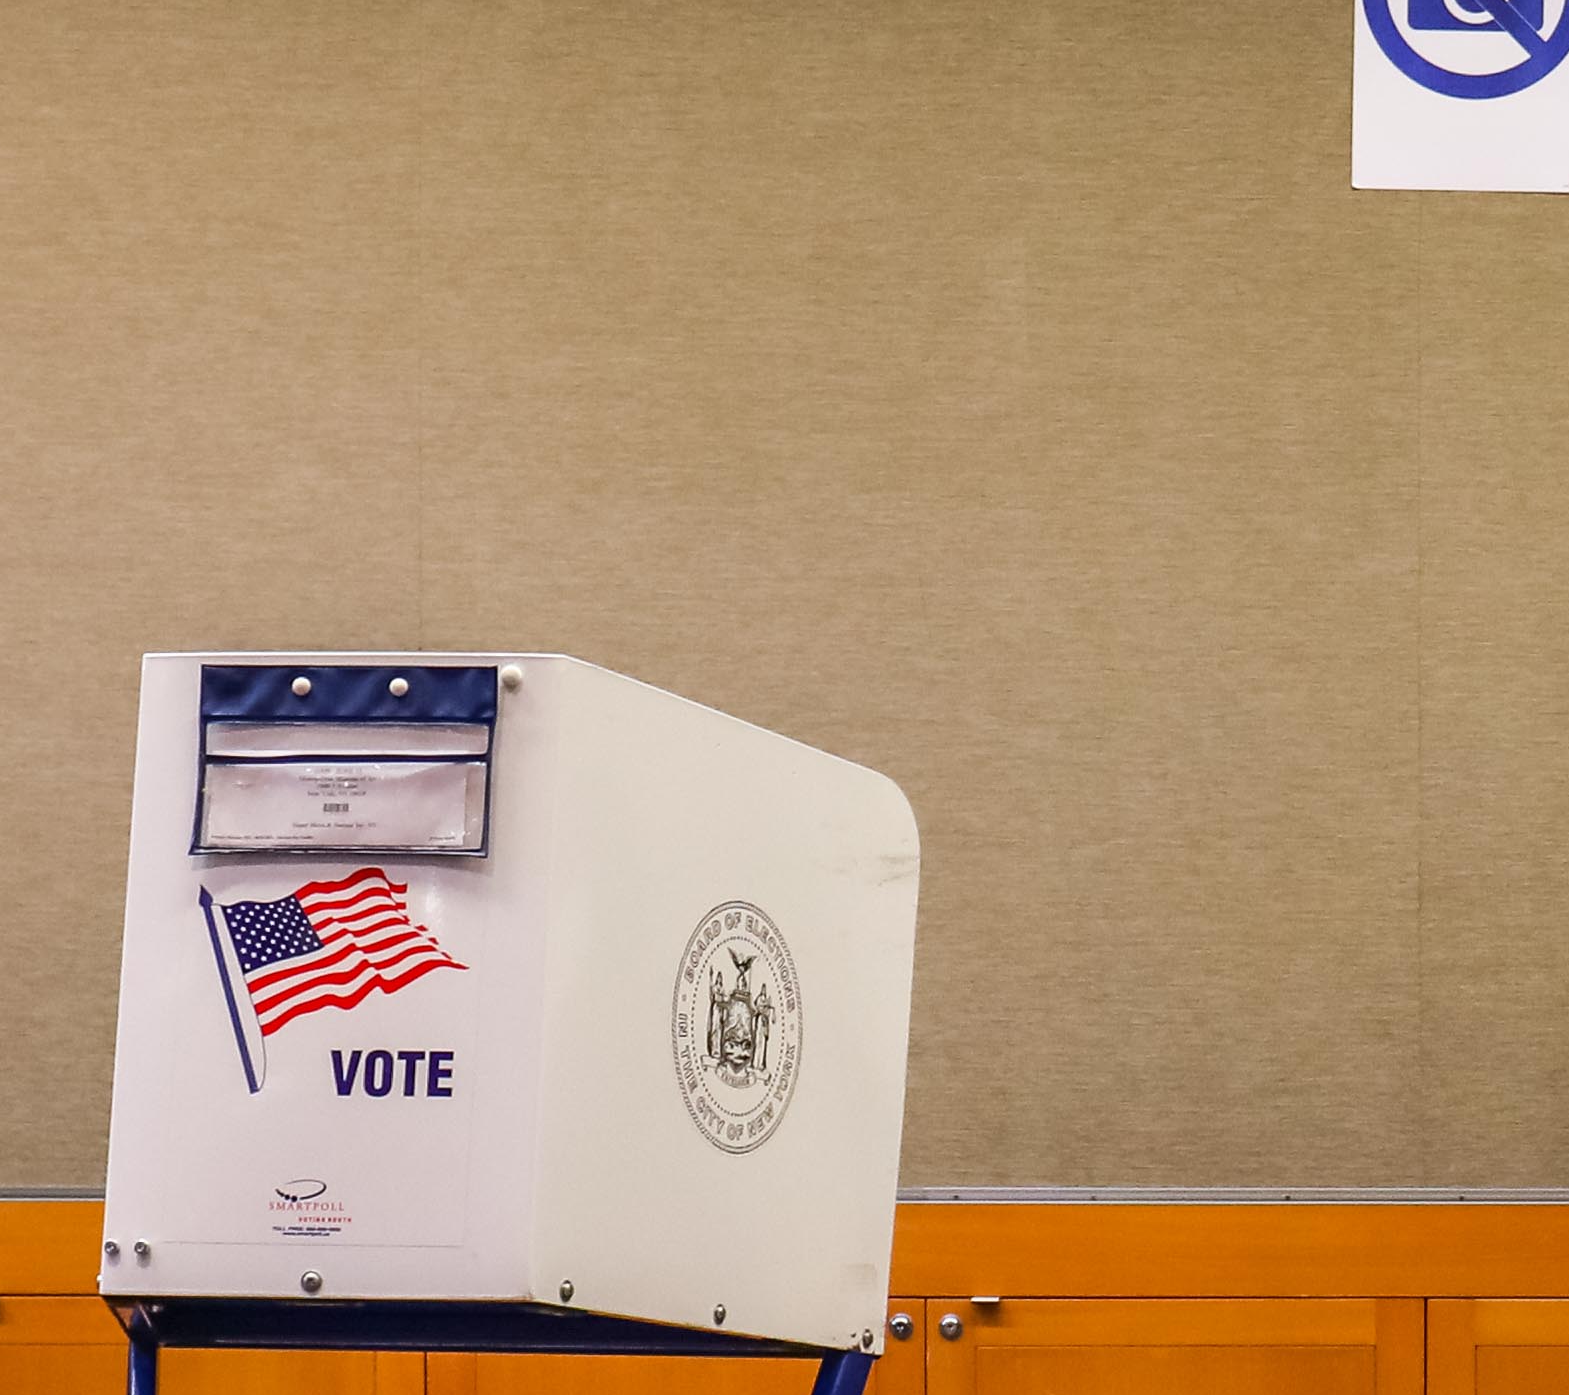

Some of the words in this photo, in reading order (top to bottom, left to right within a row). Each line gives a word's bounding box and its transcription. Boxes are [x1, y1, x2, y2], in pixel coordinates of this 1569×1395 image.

[684, 919, 721, 984] BOARD
[724, 912, 742, 930] OF
[745, 915, 796, 1014] ELECTIONS
[678, 1013, 688, 1038] IN
[330, 1049, 454, 1097] VOTE
[681, 1045, 698, 1095] THE
[773, 1043, 796, 1101] YORK
[696, 1096, 725, 1135] CITY
[727, 1123, 745, 1141] OF
[747, 1101, 775, 1139] NEW
[269, 1202, 344, 1211] SMARTPOLL
